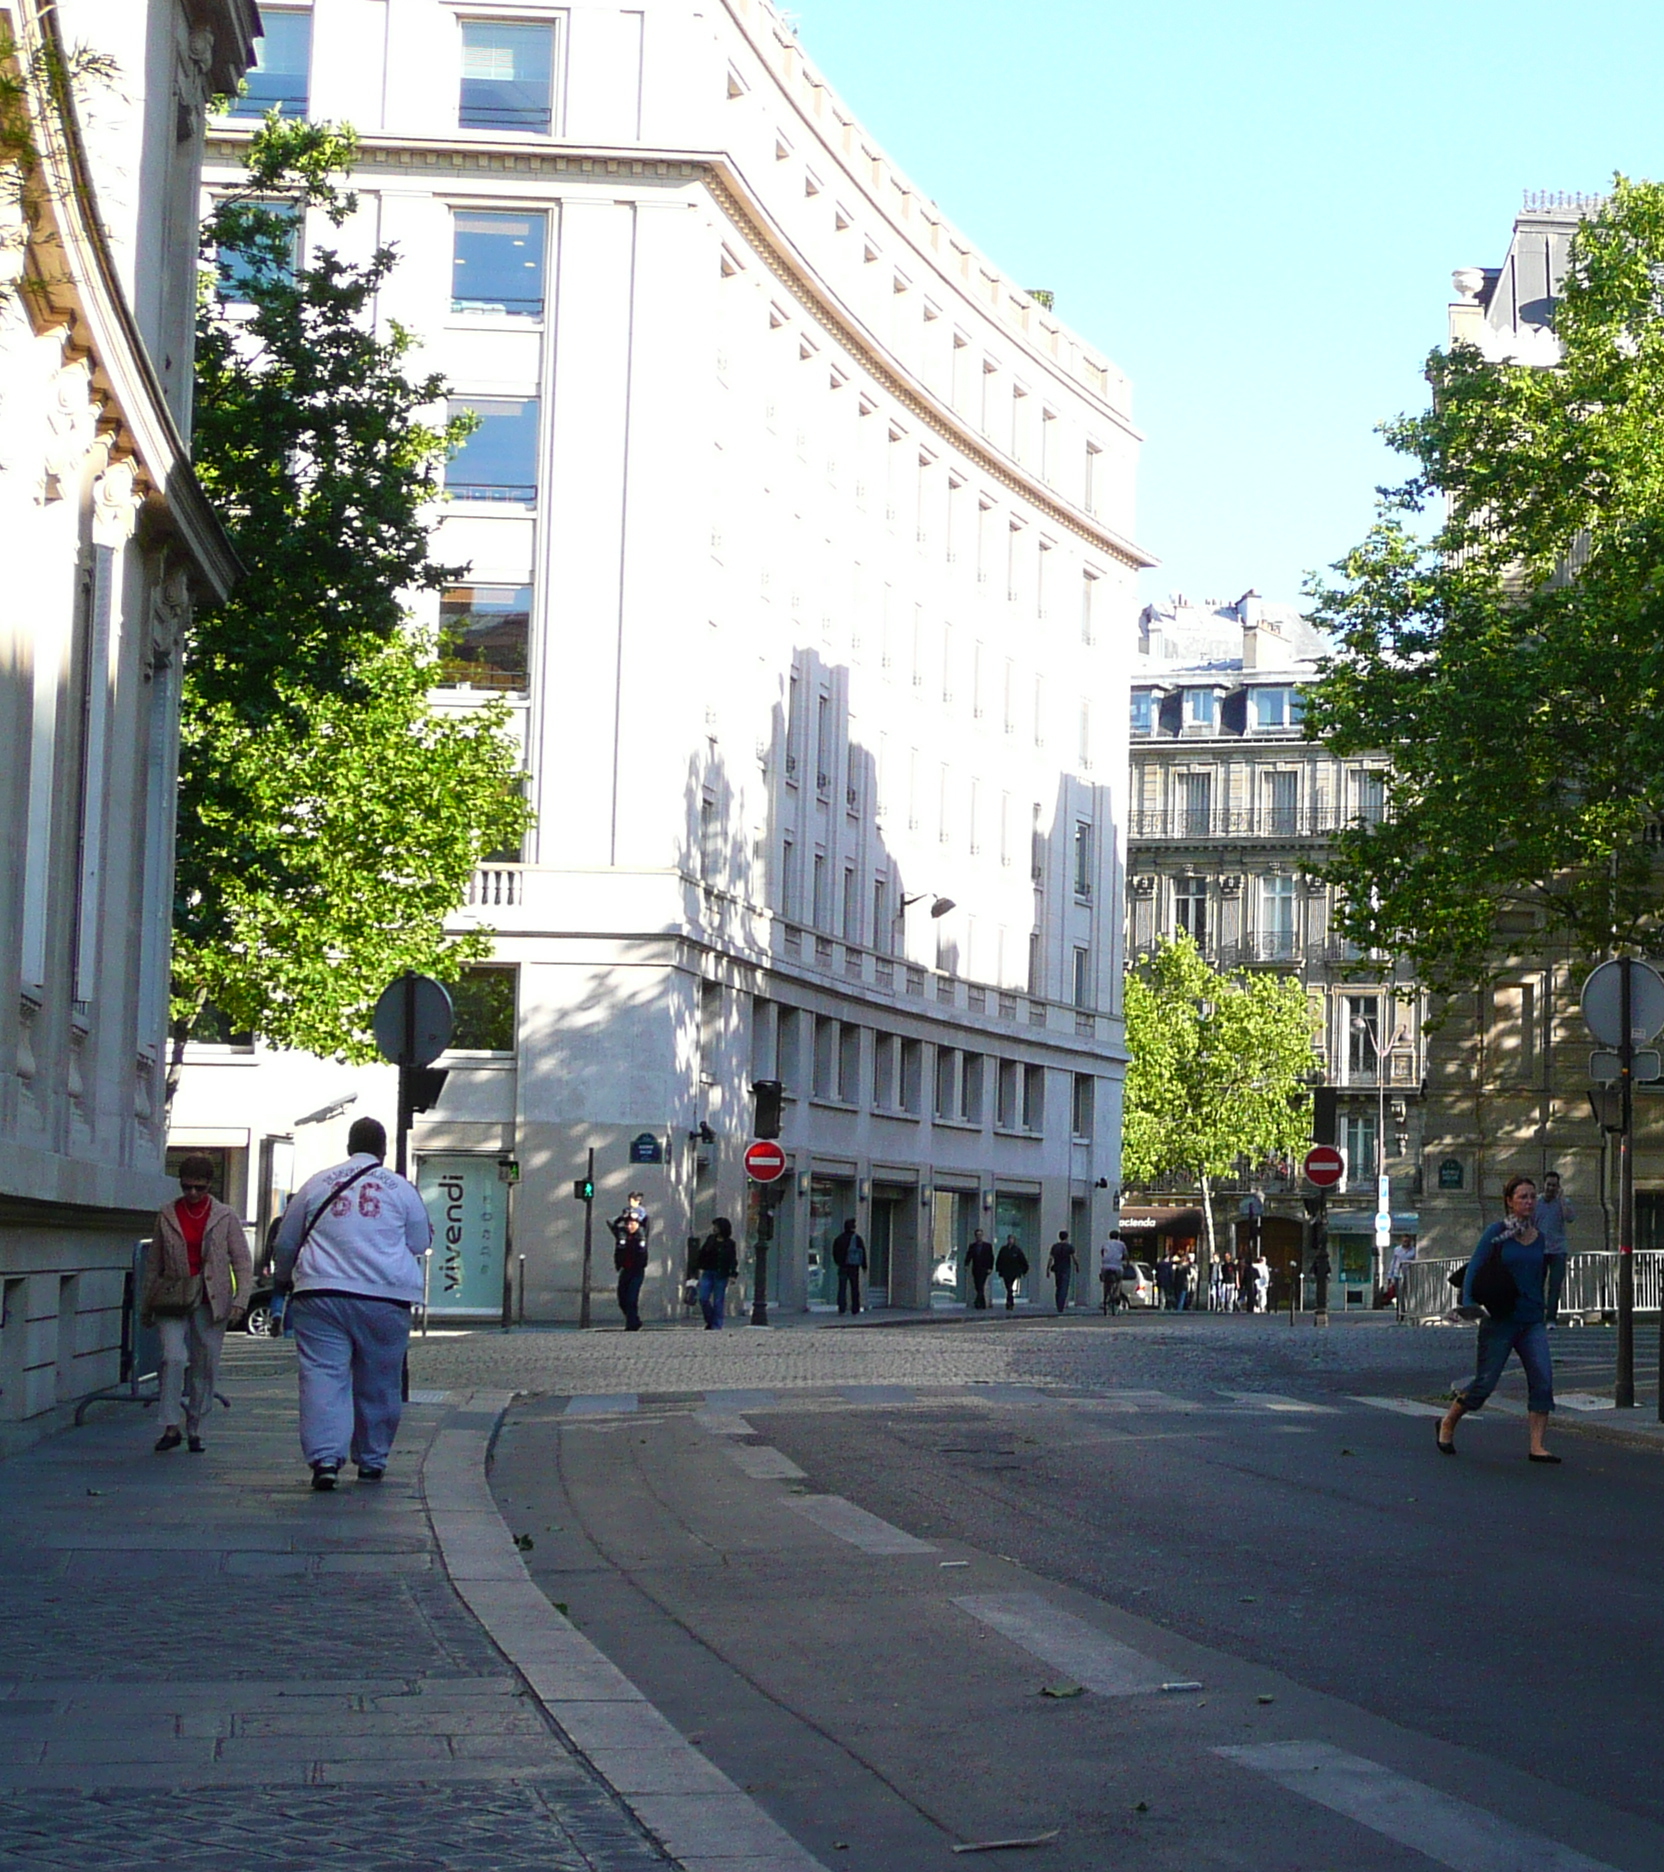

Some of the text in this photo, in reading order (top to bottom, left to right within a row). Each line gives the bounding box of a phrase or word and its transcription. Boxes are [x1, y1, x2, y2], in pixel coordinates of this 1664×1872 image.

[329, 1180, 382, 1219] 66
[438, 1175, 464, 1292] vivendi
[1118, 1216, 1156, 1228] acienda
